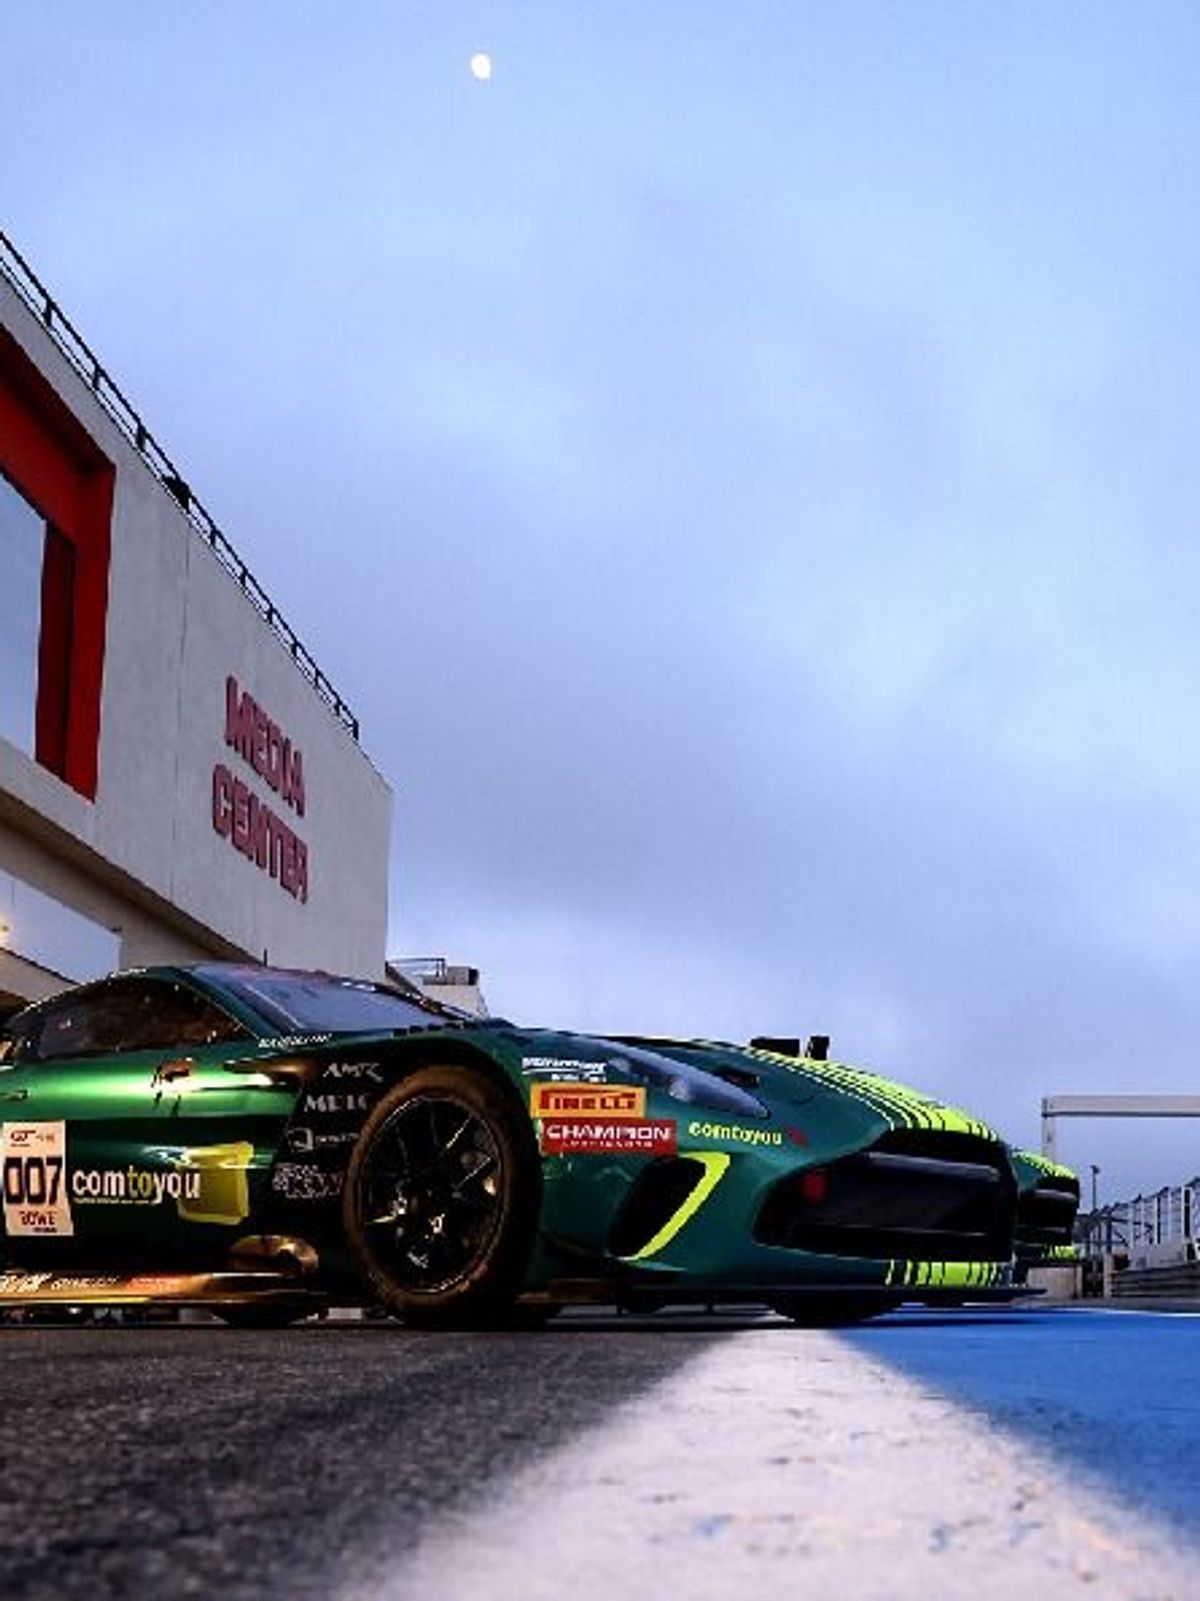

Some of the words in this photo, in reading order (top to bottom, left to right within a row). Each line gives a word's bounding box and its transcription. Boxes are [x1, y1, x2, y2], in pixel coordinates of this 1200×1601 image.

[225, 675, 305, 817] MEDIA
[213, 764, 308, 904] CENTER
[540, 1089, 636, 1109] PIRELLI
[546, 1124, 670, 1140] CHAMPION
[688, 1122, 783, 1146] comtoyou
[4, 1156, 63, 1205] 007
[72, 1164, 201, 1205] comtoyou
